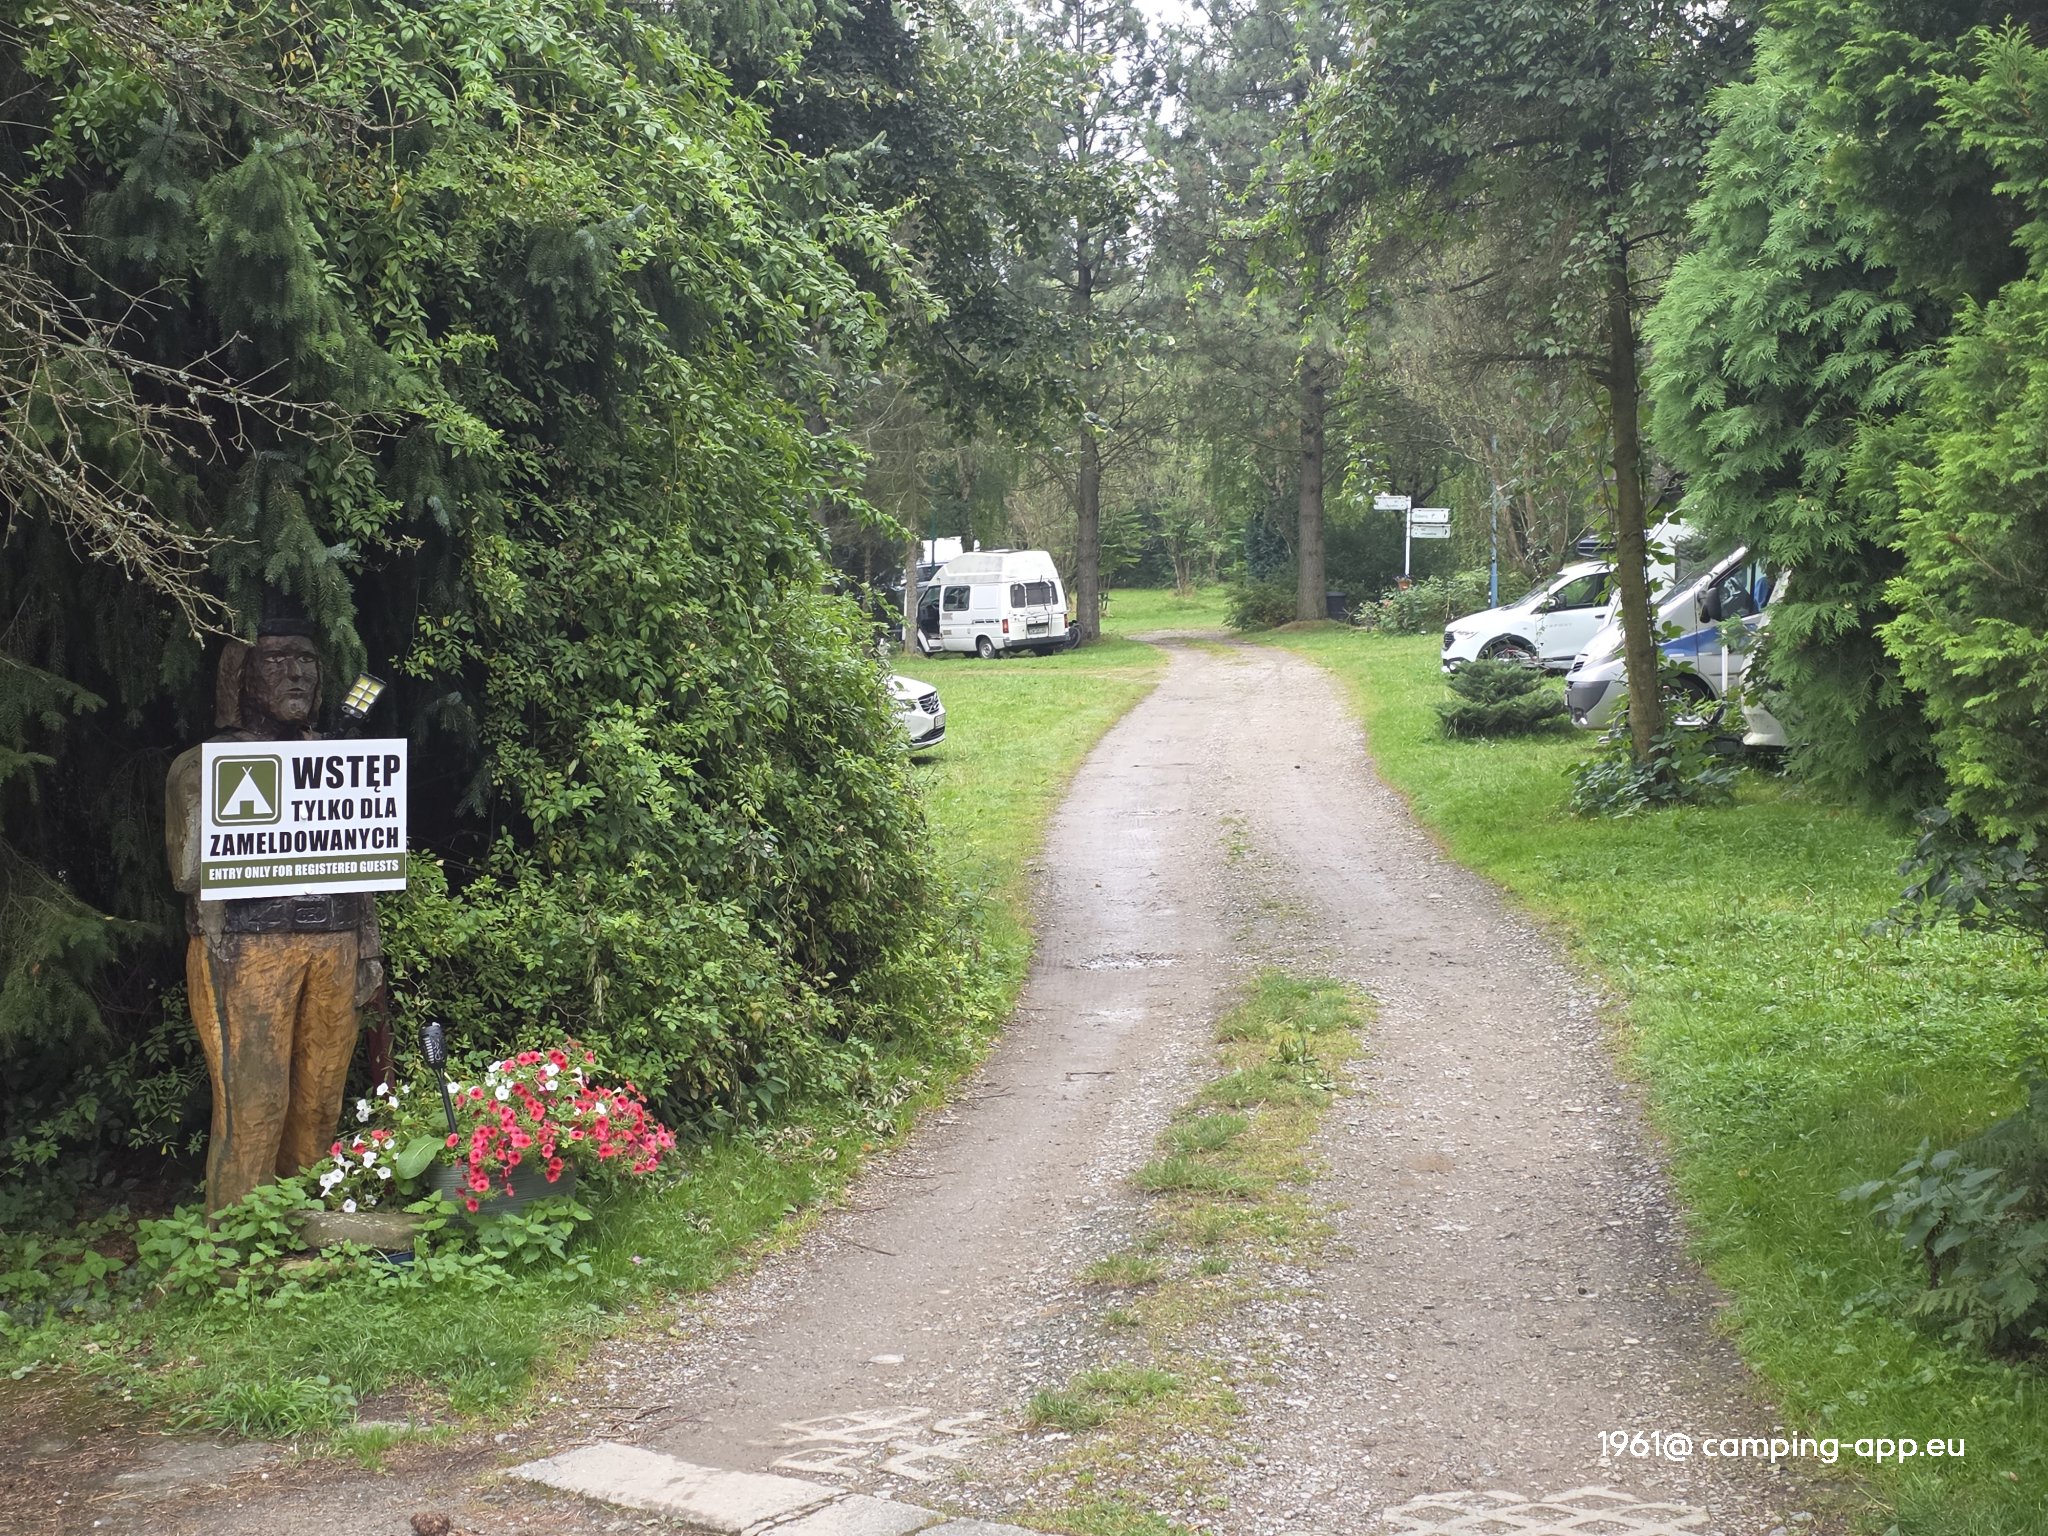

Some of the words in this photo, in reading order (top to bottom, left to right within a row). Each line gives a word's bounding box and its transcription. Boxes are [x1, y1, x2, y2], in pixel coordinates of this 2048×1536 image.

[292, 754, 401, 793] WSTĘP
[291, 799, 354, 822] TYLKO
[360, 797, 397, 819] DLA
[210, 826, 399, 857] ZAMELDOWANYCH
[208, 867, 243, 881] ENTRY
[244, 865, 270, 879] ONLY
[272, 864, 293, 877] FOR
[294, 861, 358, 876] REGISTERED
[359, 859, 399, 873] GUESTS
